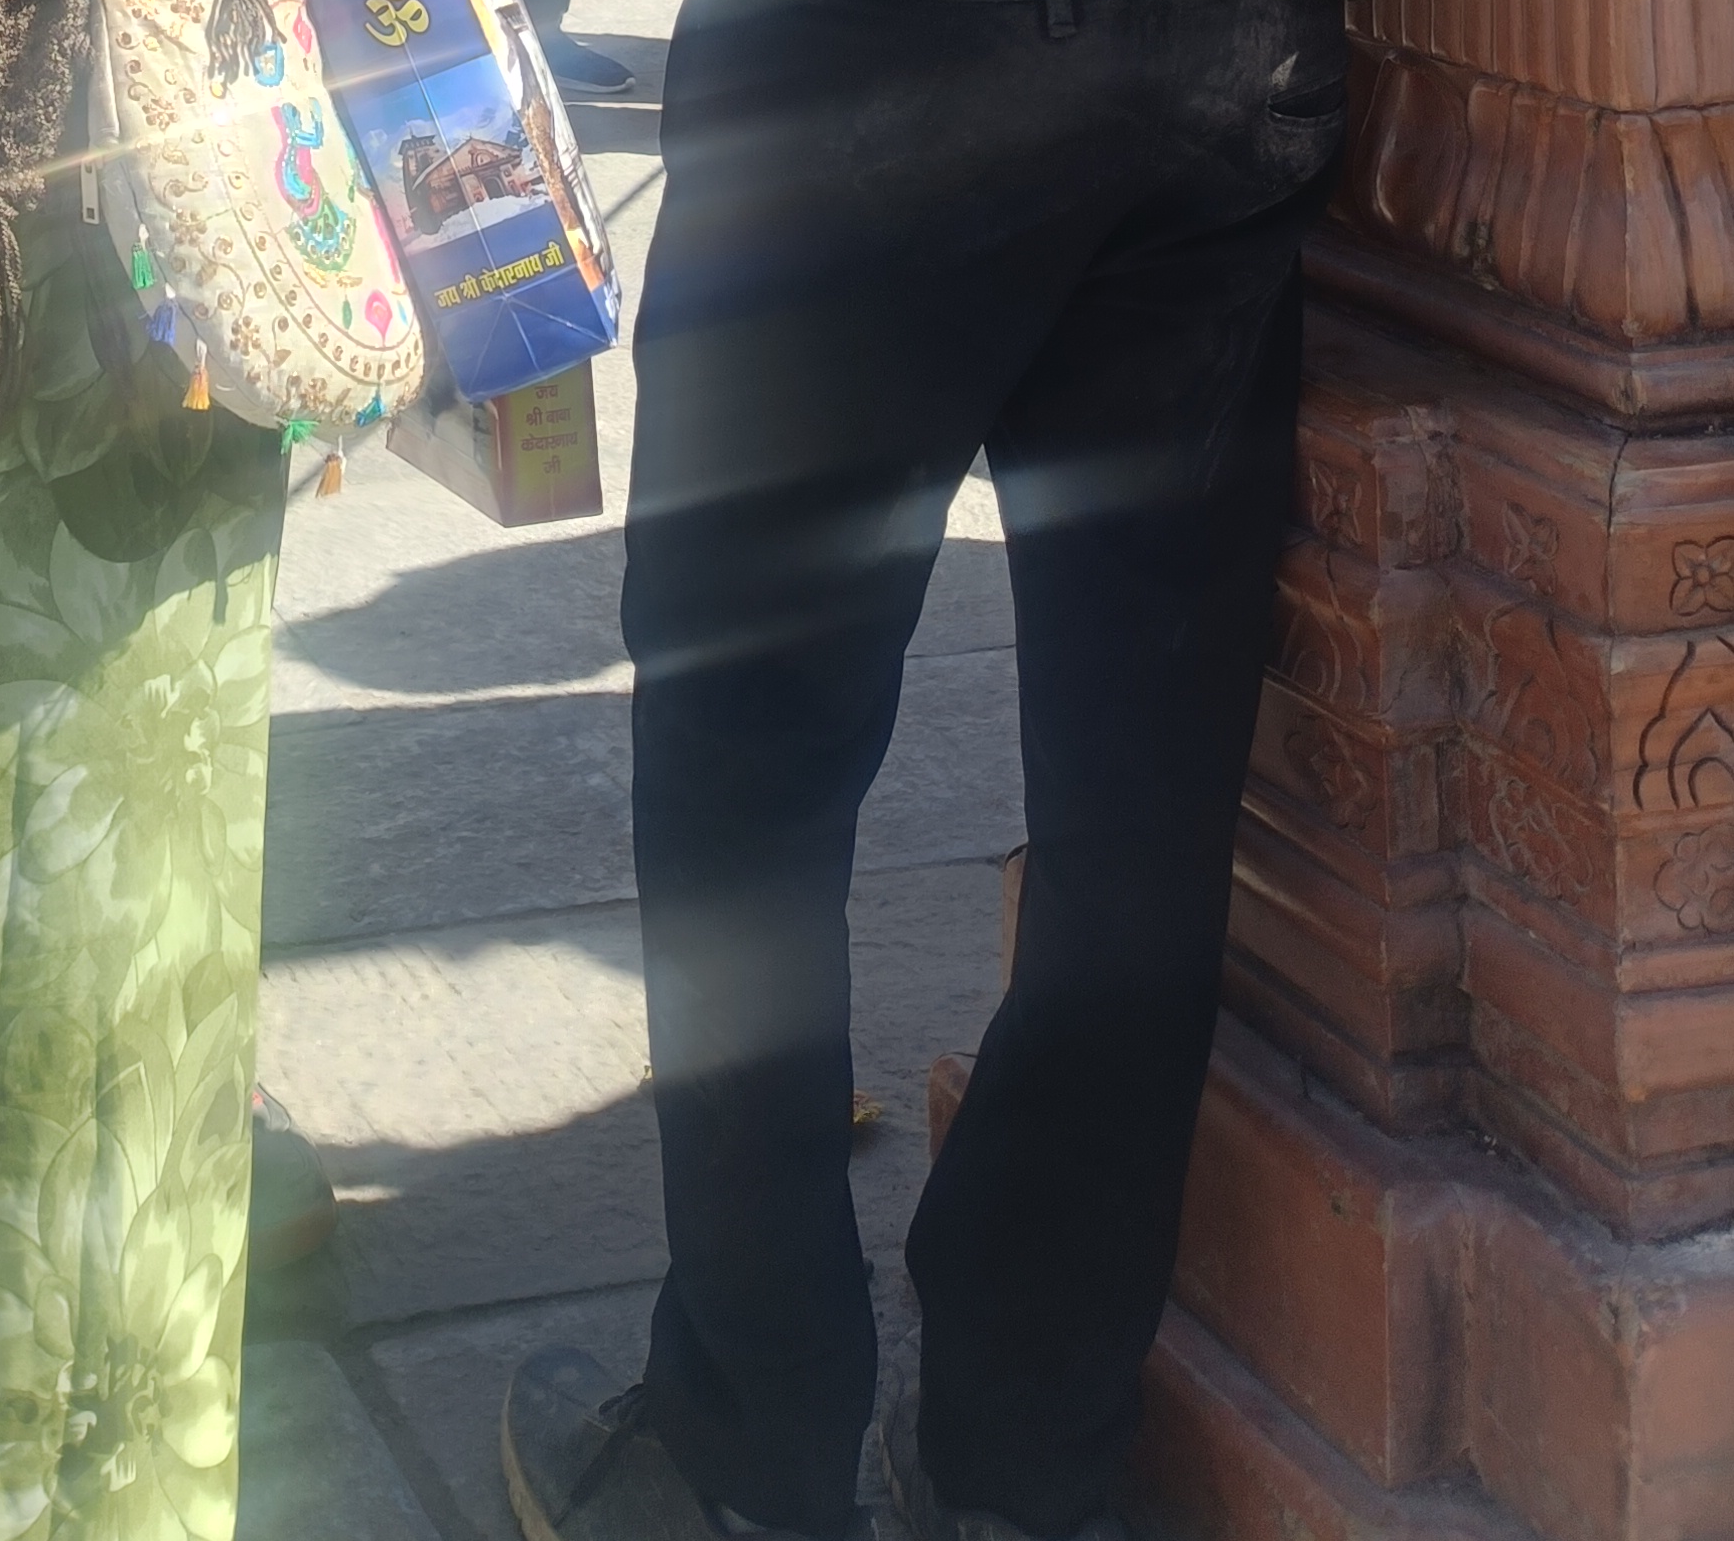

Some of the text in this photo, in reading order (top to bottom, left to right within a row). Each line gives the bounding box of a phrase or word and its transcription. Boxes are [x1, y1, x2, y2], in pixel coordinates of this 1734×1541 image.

[434, 240, 565, 309] जय श्री केदारनाथ जी
[533, 384, 559, 400] जय
[525, 405, 544, 427] श्री
